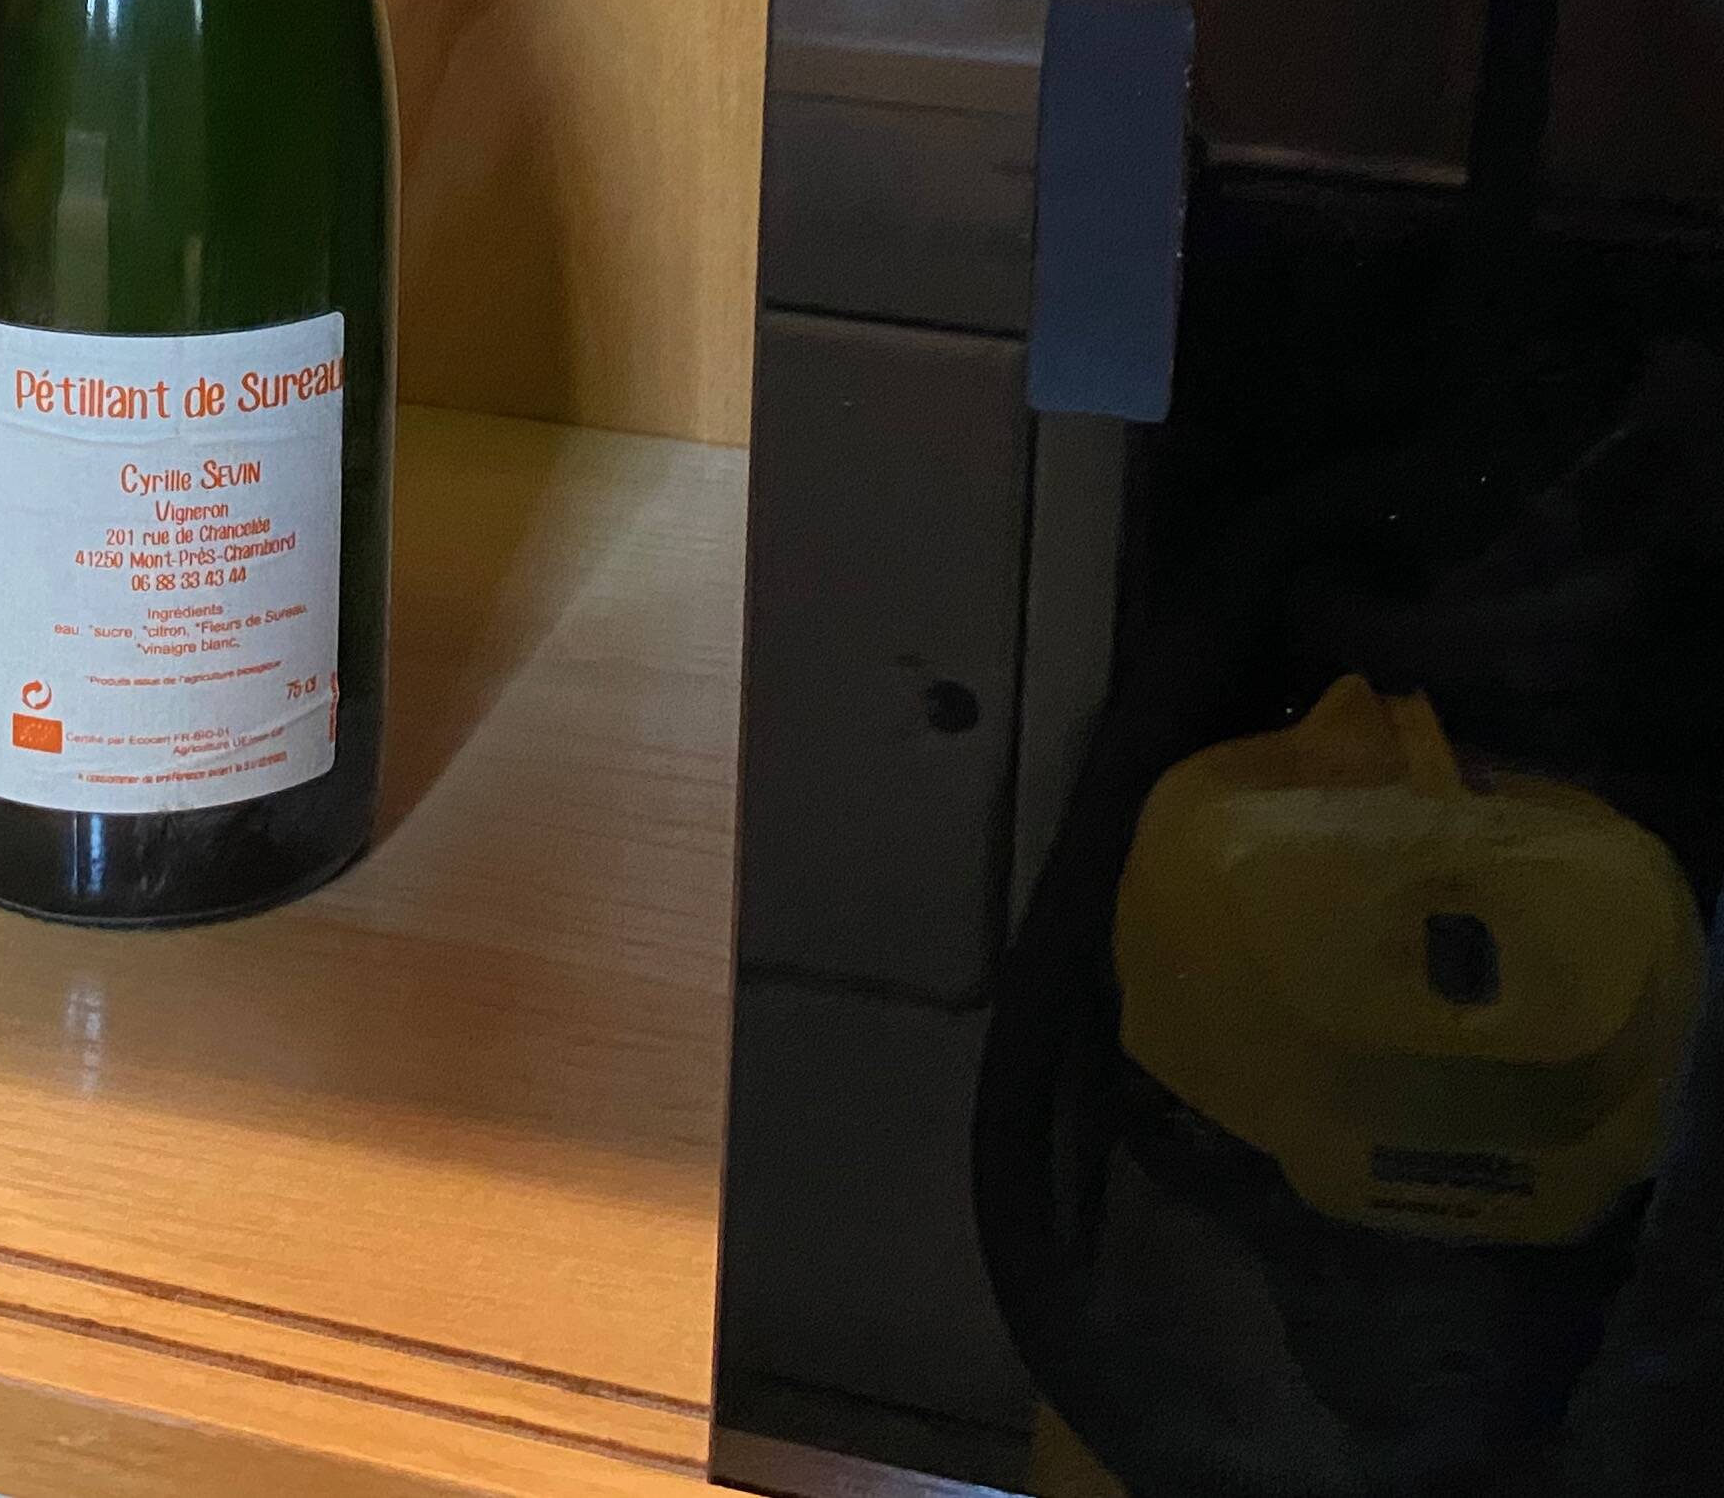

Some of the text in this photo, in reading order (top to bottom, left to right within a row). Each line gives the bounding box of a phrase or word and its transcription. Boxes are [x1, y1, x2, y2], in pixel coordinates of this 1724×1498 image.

[15, 357, 345, 419] Pétillant de Sureau
[121, 460, 261, 496] Cyrille SEVIN
[155, 500, 229, 525] Vigneron
[105, 529, 134, 546] 201
[143, 530, 169, 546] rue
[176, 527, 193, 544] de
[75, 550, 123, 569] 41250
[132, 566, 247, 591] 06 88 33 43 44
[147, 604, 224, 622] Ingrédients
[245, 613, 262, 628] de
[286, 680, 302, 700] 75
